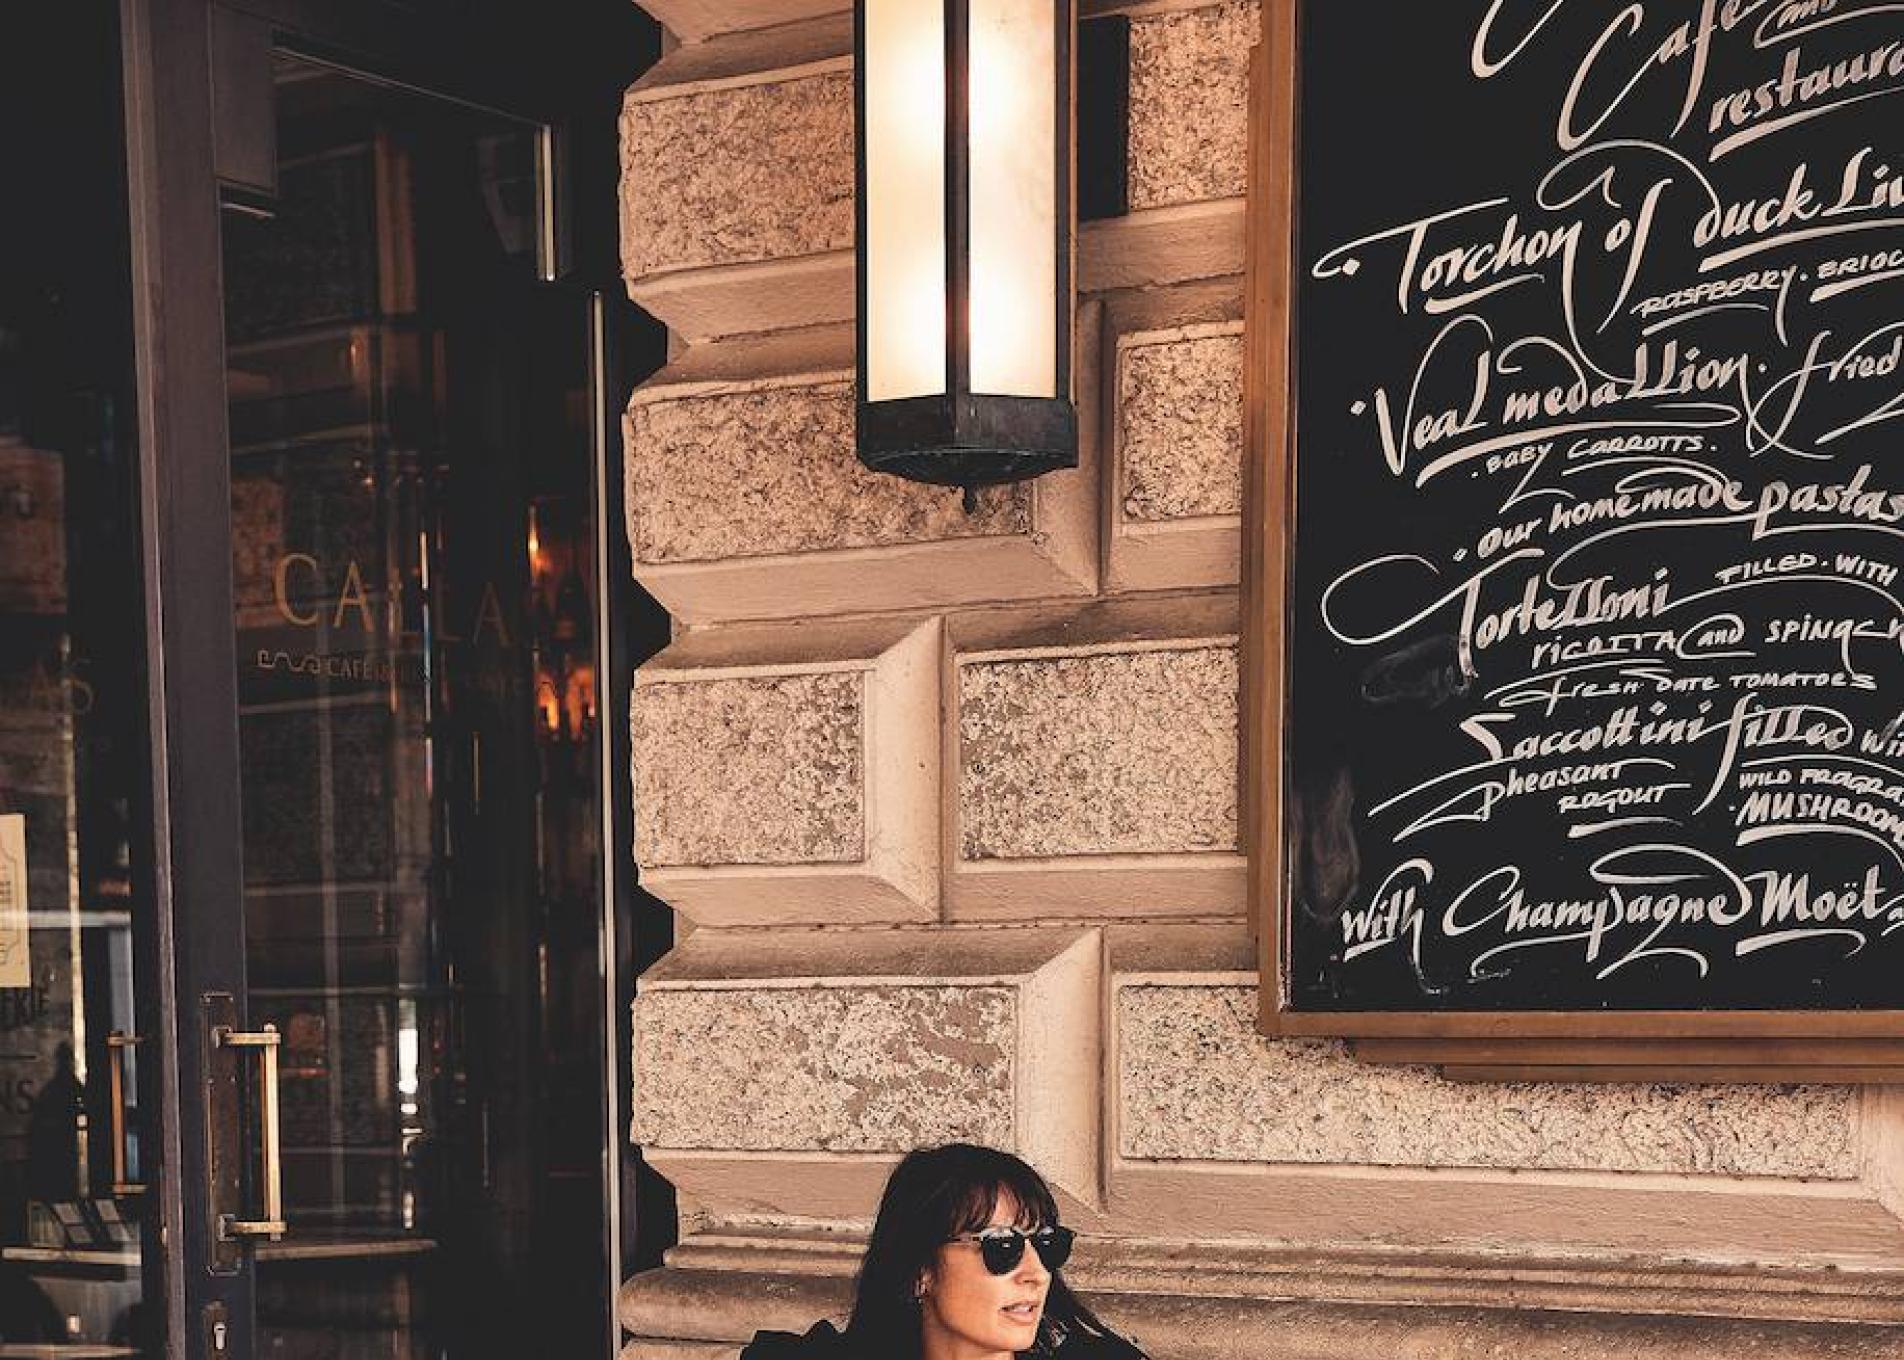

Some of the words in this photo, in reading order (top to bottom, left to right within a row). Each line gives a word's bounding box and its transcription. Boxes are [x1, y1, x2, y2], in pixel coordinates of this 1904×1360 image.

[1312, 197, 1584, 320] Torchon
[1597, 178, 1673, 335] of
[1692, 163, 1822, 249] duck
[1374, 314, 1494, 477] Veal
[1497, 336, 1751, 432] medallion
[1752, 329, 1904, 454] fried
[1478, 518, 1542, 558] our
[1549, 469, 1753, 534] homemade
[1380, 549, 1671, 677] Tortelloni
[1714, 552, 1817, 584] FILLED
[1835, 553, 1899, 587] WITH
[1729, 671, 1878, 691] TOMATOES
[1460, 699, 1713, 762] Saccottini
[1692, 692, 1854, 813] filled
[1739, 769, 1793, 790] WILD
[1443, 862, 1752, 965] Champagne
[1744, 864, 1886, 928] Moët
